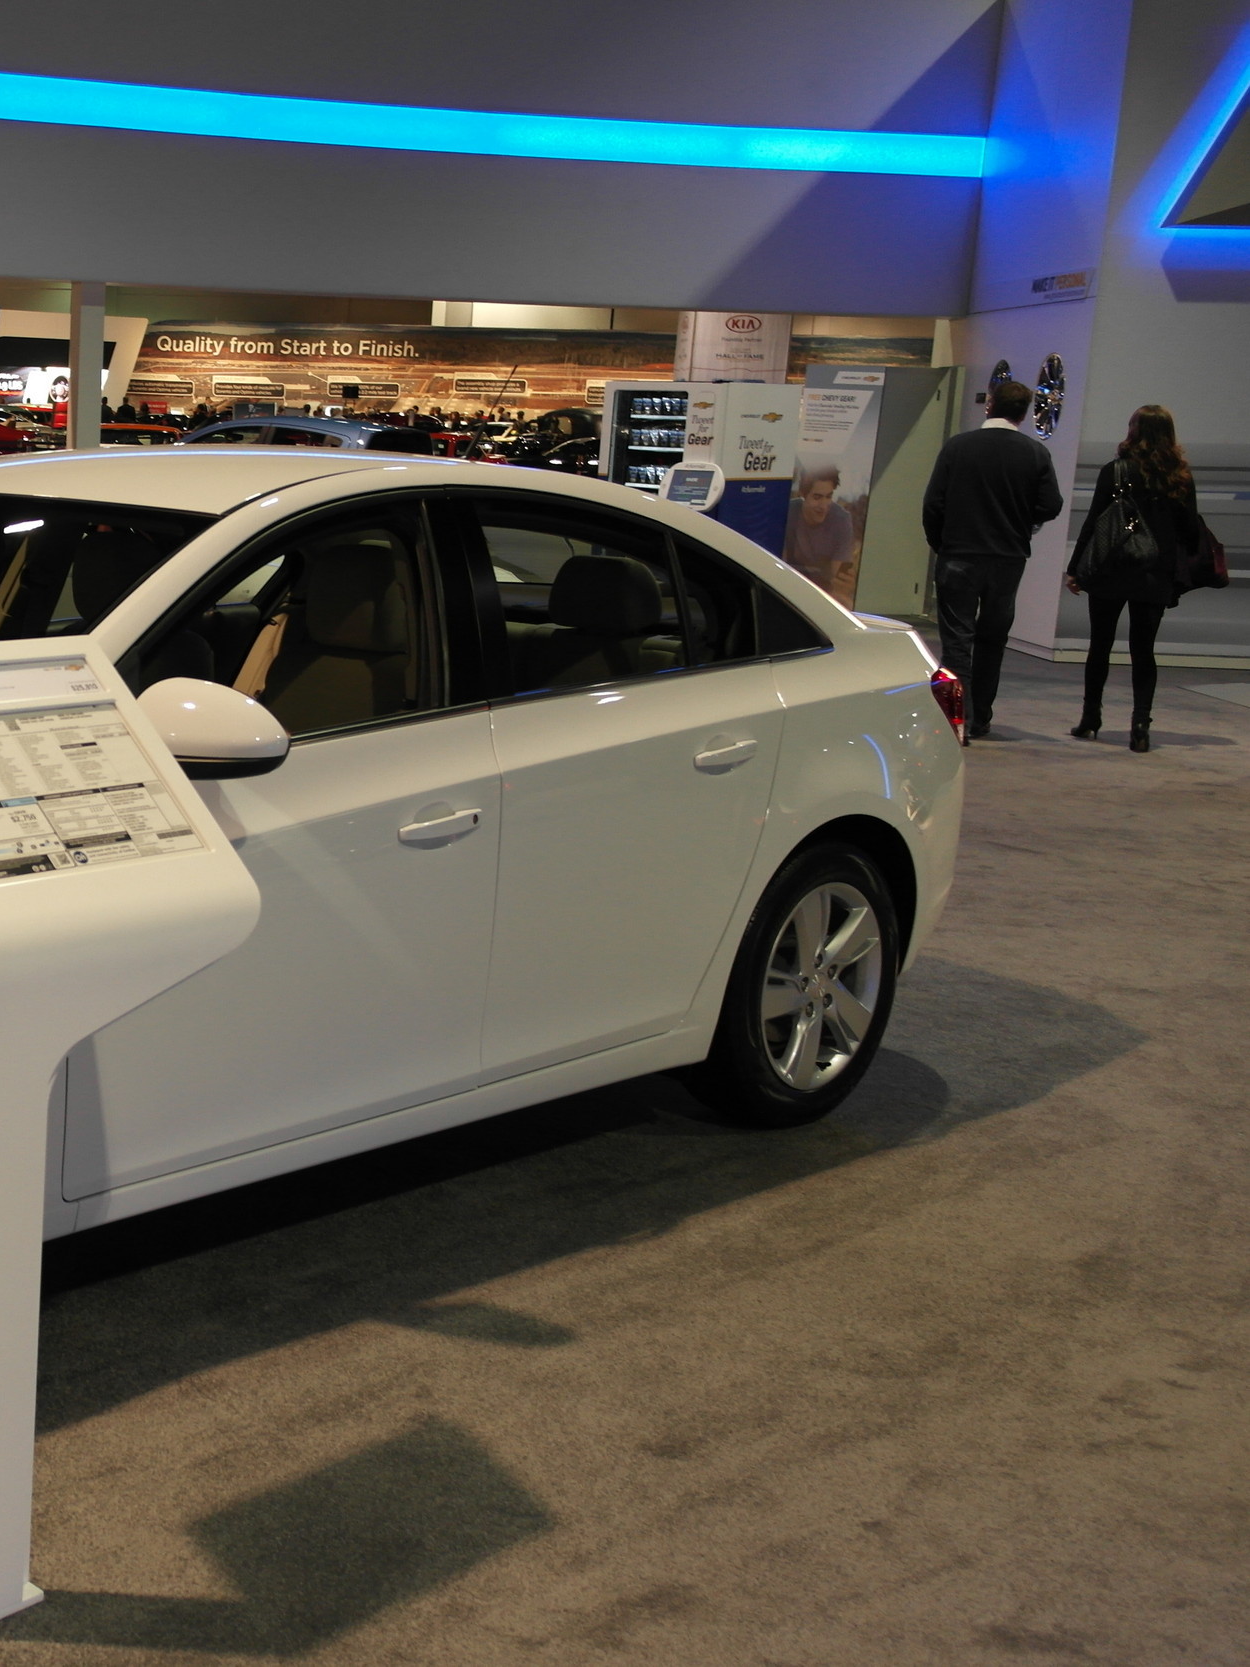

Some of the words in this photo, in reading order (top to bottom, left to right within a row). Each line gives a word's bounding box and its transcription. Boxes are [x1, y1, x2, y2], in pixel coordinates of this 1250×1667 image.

[731, 319, 755, 329] KIA
[156, 335, 225, 356] Quality
[230, 337, 275, 354] from
[280, 339, 327, 355] Start
[332, 341, 352, 356] to
[358, 340, 420, 358] Finish.
[687, 433, 714, 445] Gear
[739, 435, 764, 450] Tweet
[744, 451, 776, 471] Gear
